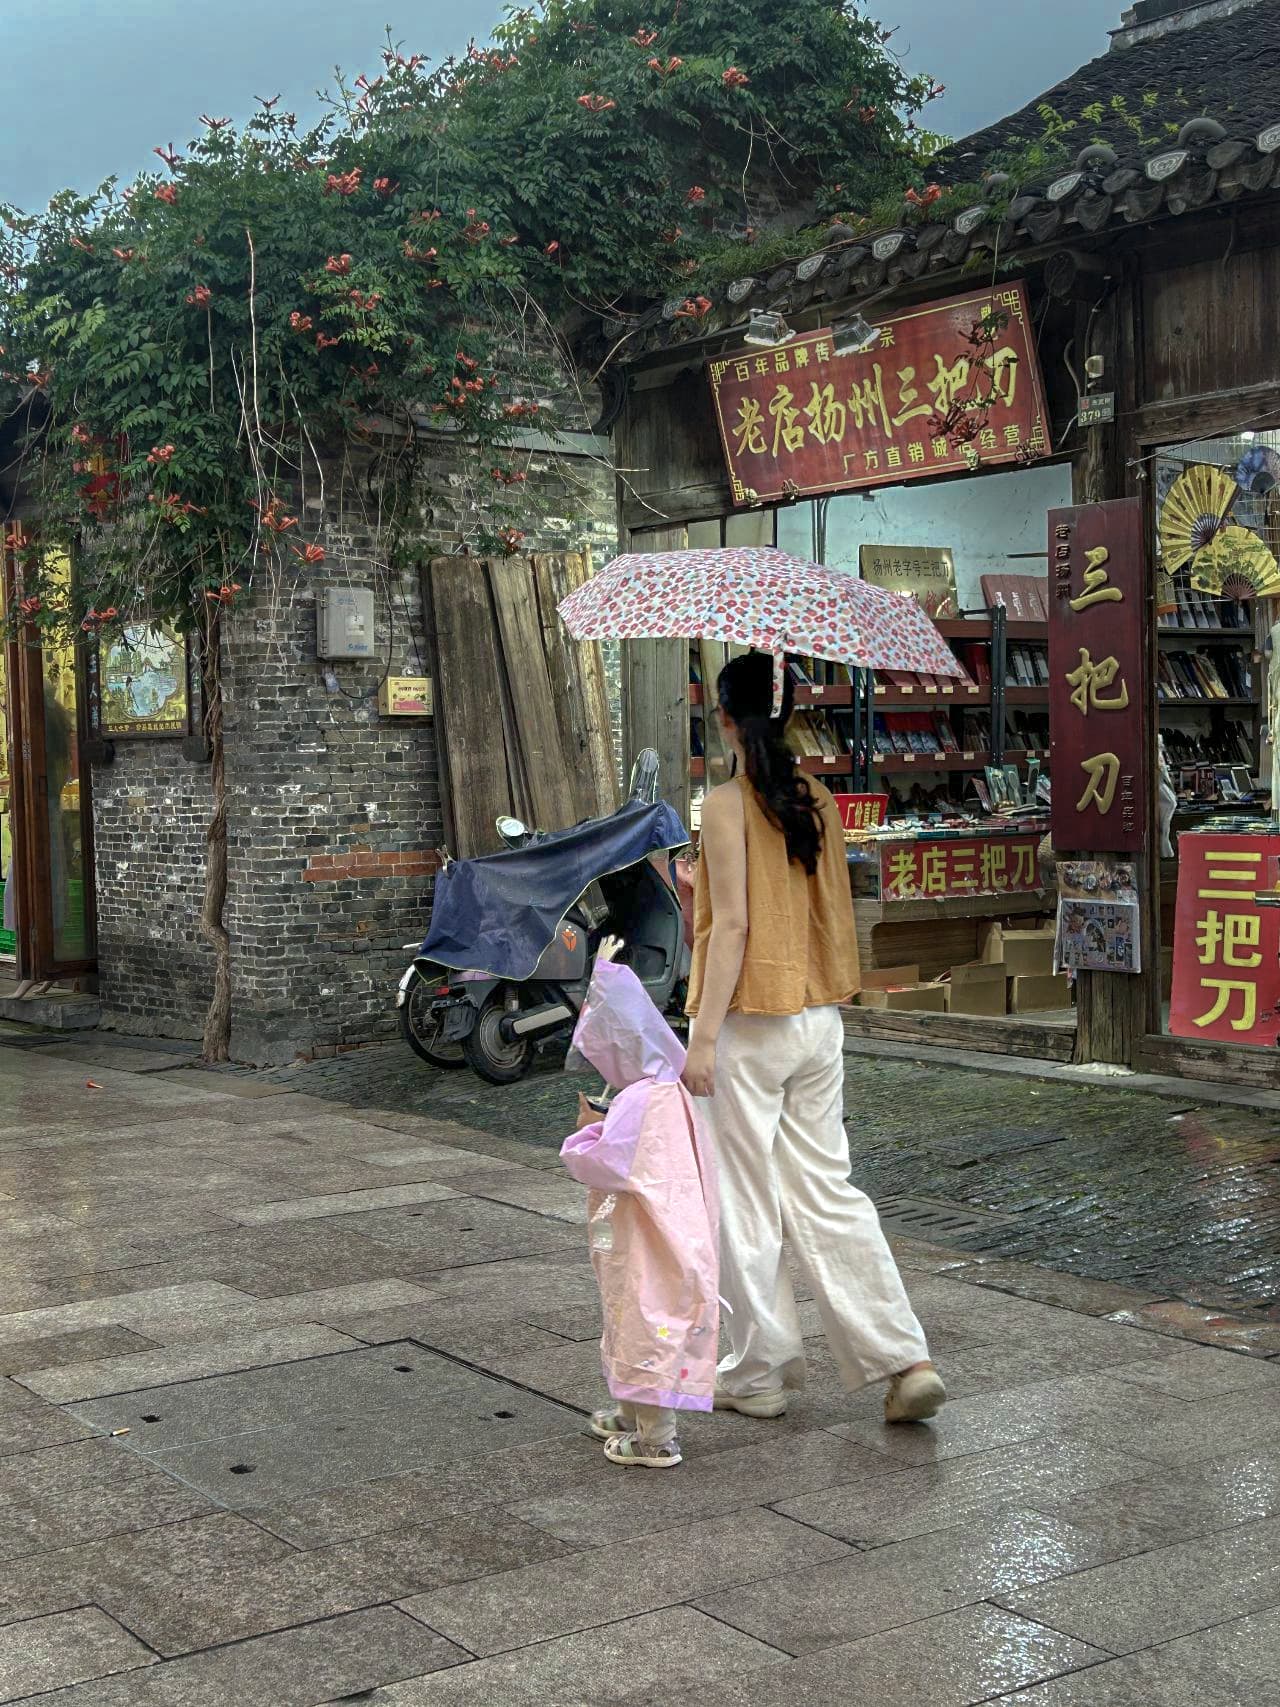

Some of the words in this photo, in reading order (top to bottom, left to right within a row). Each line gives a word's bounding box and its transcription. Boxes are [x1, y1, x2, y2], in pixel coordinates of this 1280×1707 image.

[731, 346, 1019, 457] 老店扬州三把刀
[734, 327, 896, 382] 百年品牌传宗
[1066, 547, 1128, 815] 三把刀
[887, 844, 1035, 898] 老店三把刀
[1192, 852, 1262, 1031] 三把刀
